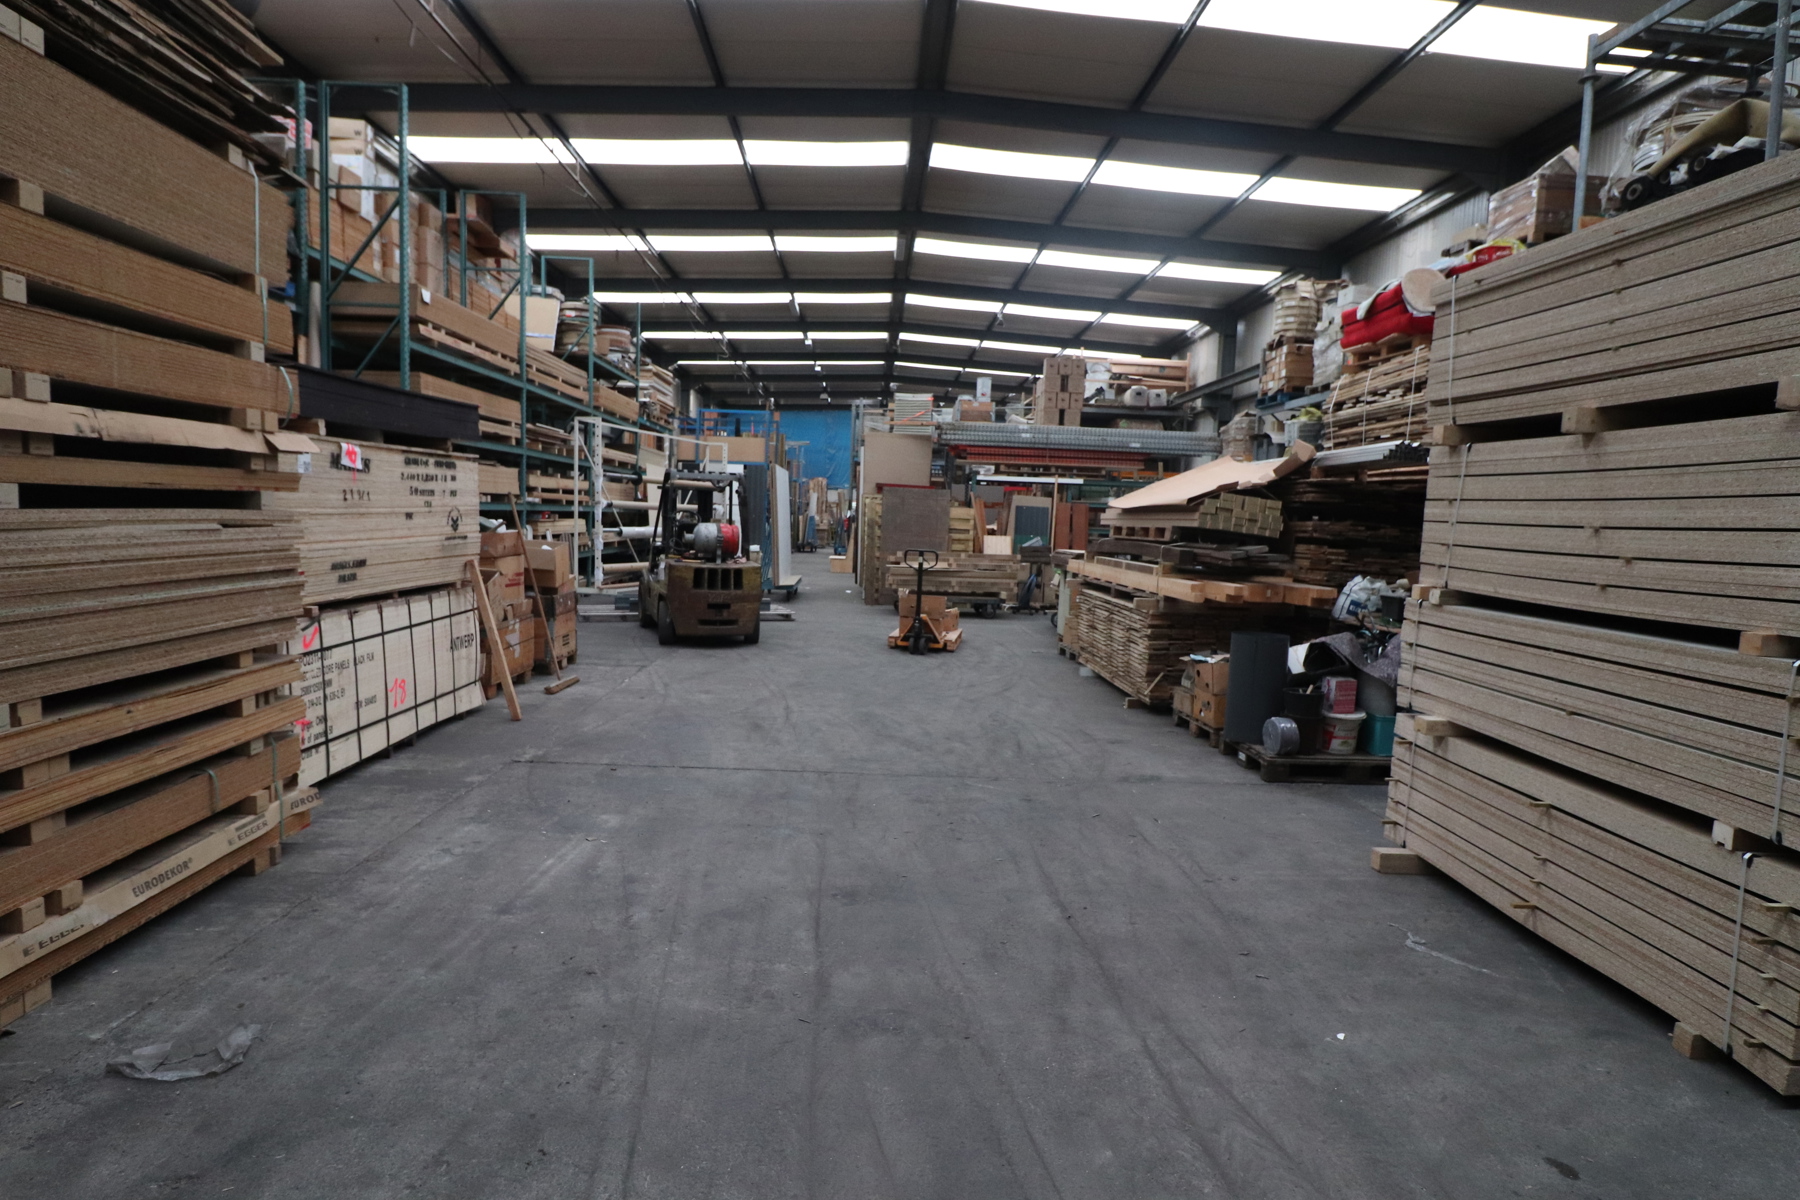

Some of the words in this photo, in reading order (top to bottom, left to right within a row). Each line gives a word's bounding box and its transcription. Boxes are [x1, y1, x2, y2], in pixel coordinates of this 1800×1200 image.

[450, 632, 475, 653] ANTWERP
[388, 677, 407, 709] 18
[237, 819, 269, 841] EGGER
